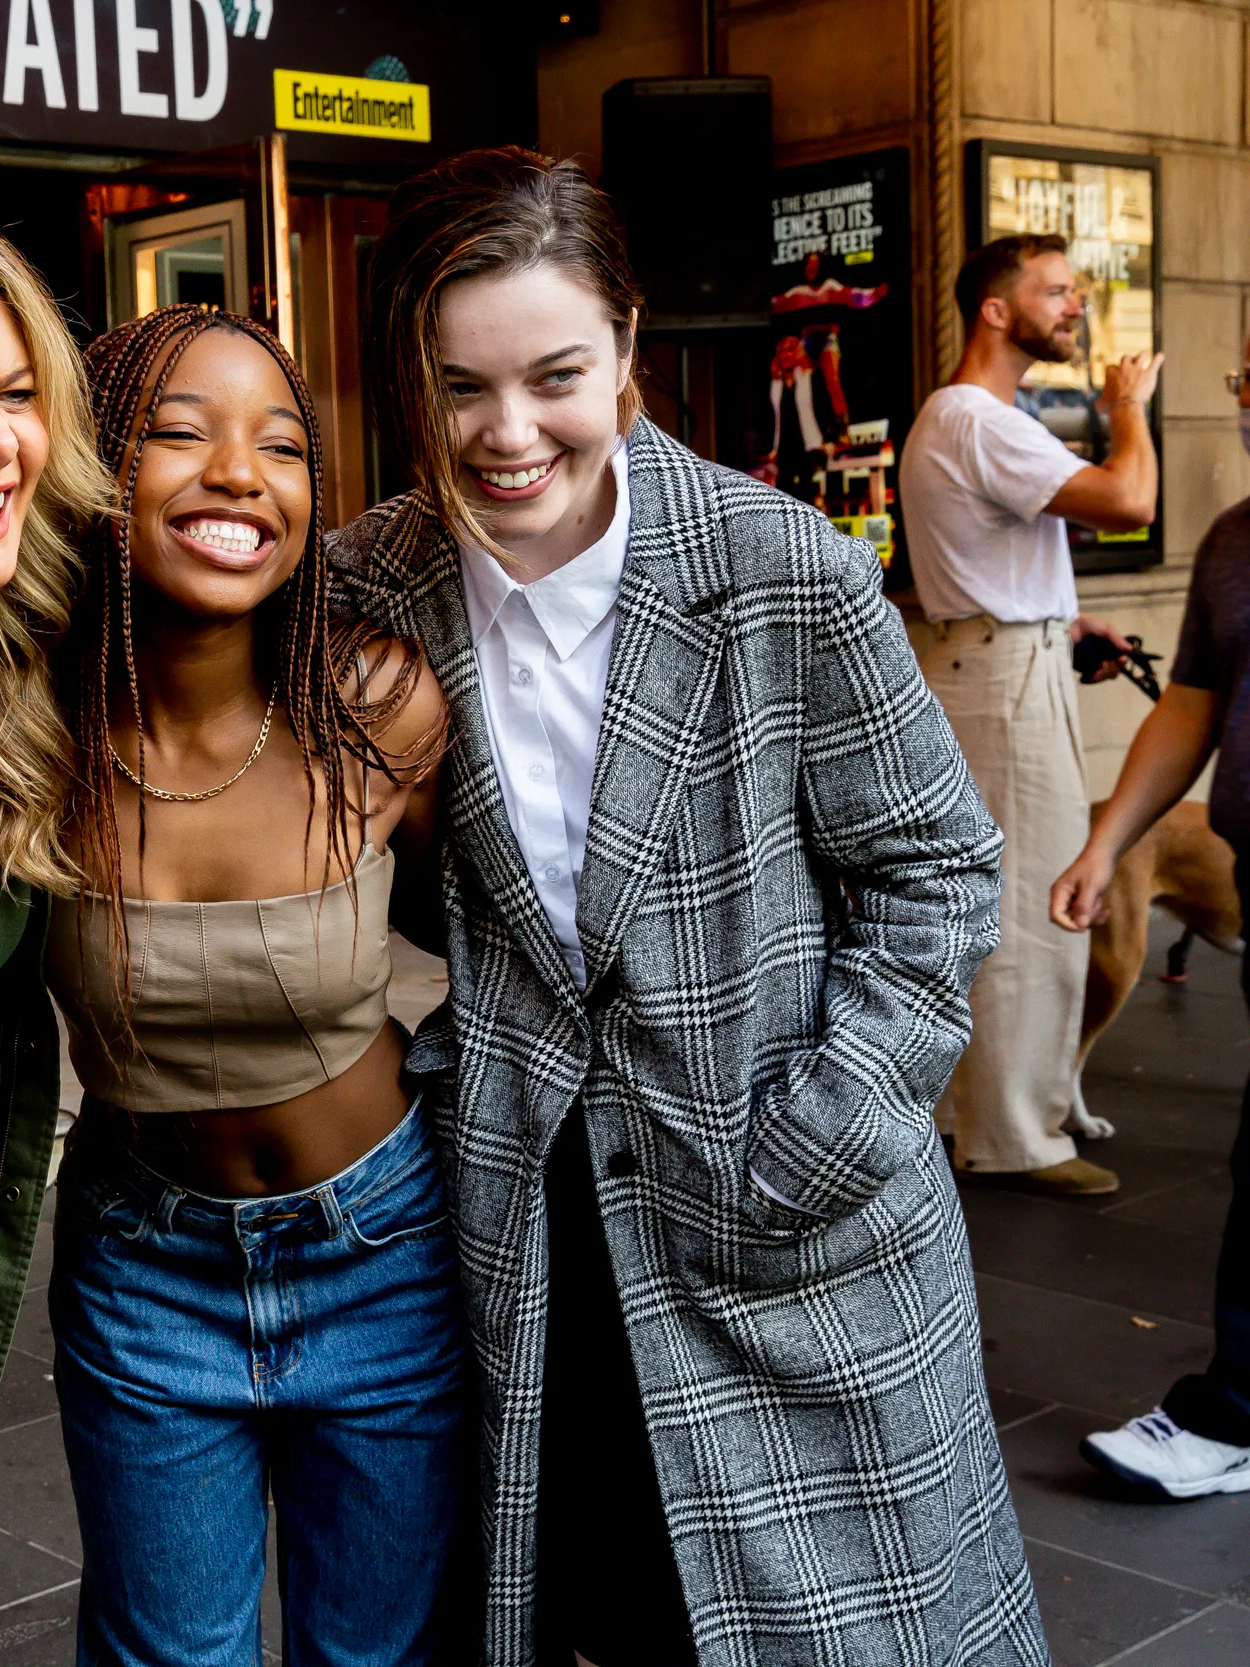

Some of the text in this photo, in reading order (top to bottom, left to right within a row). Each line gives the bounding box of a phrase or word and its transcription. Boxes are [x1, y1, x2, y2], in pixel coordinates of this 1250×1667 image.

[293, 82, 415, 131] Entertainment
[782, 194, 801, 214] THE
[802, 181, 873, 211] SCREAMING
[825, 206, 846, 233] TO
[847, 201, 874, 230] ITS
